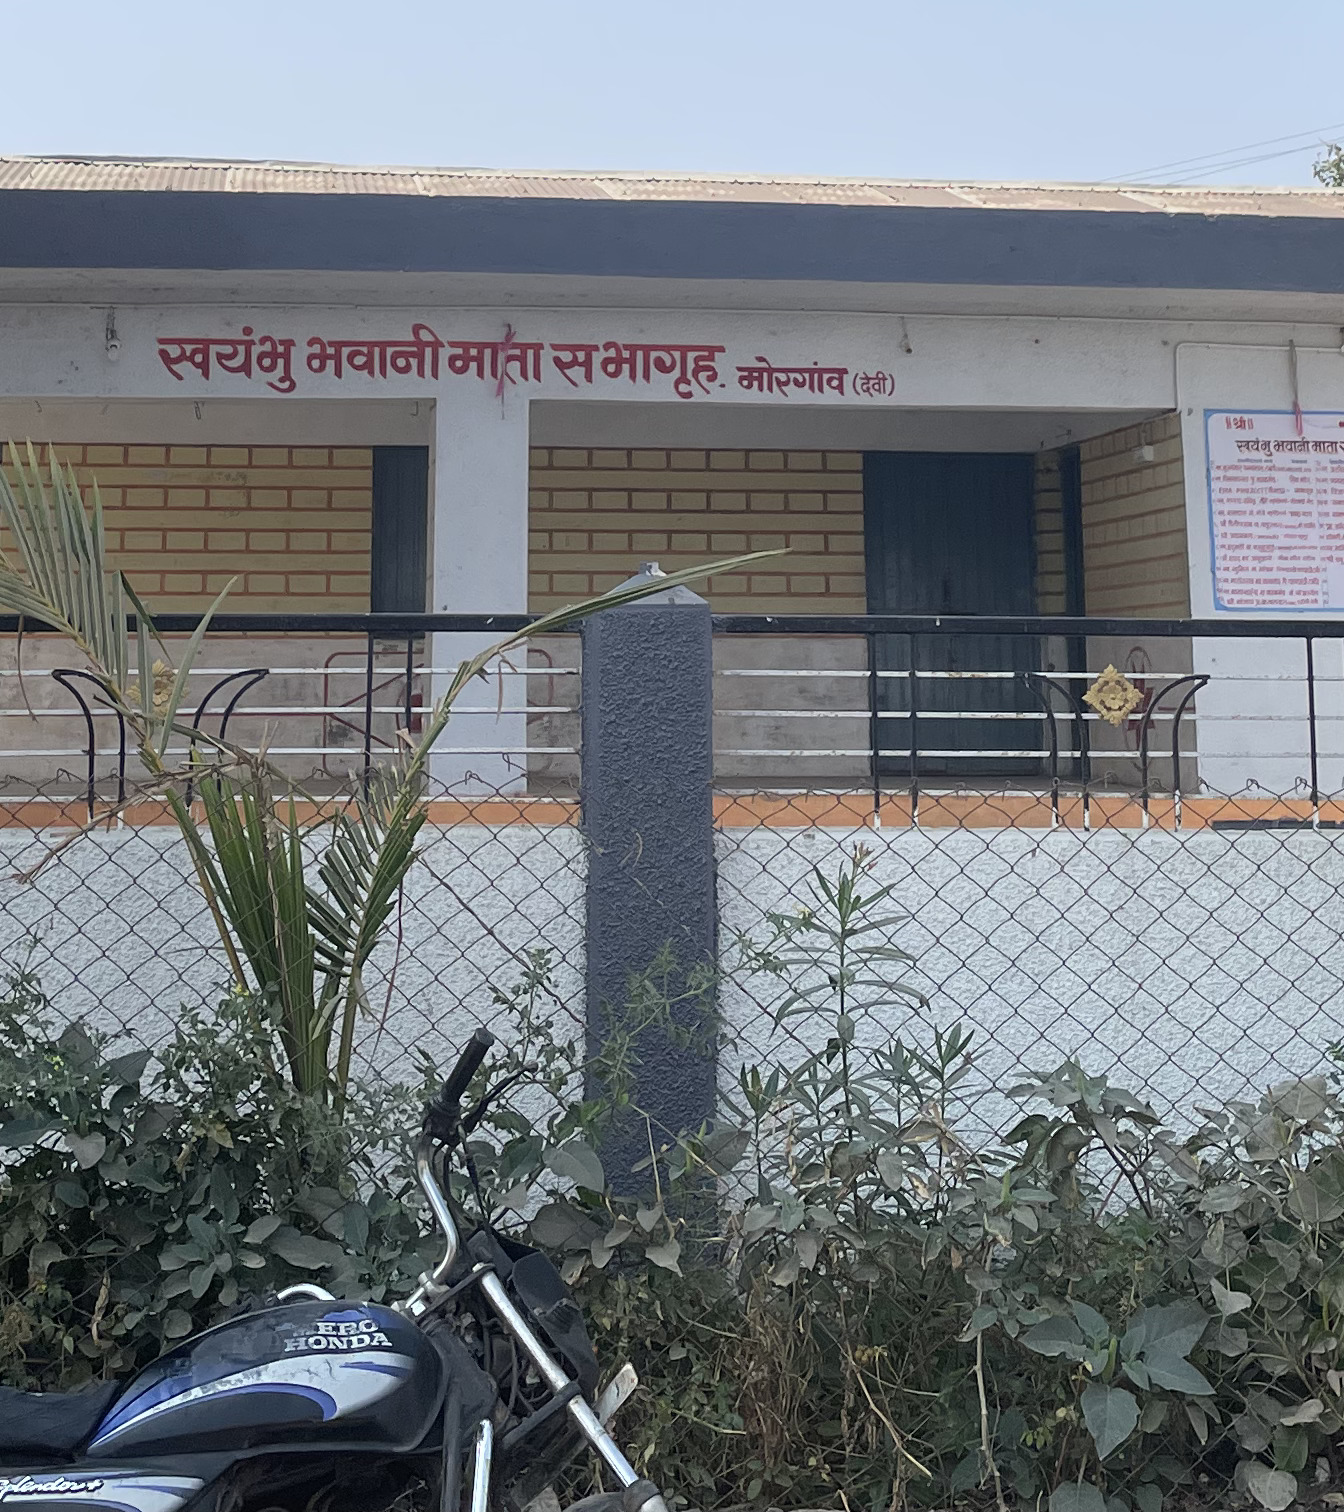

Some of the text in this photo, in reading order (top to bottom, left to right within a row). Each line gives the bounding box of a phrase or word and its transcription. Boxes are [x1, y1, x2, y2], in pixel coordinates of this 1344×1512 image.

[156, 326, 296, 393] स्वयंभु
[306, 324, 445, 380] भवानी
[446, 335, 544, 384] माता
[736, 355, 849, 398] मोरगांव
[1311, 440, 1338, 454] माता
[284, 1332, 393, 1352] HONDA
